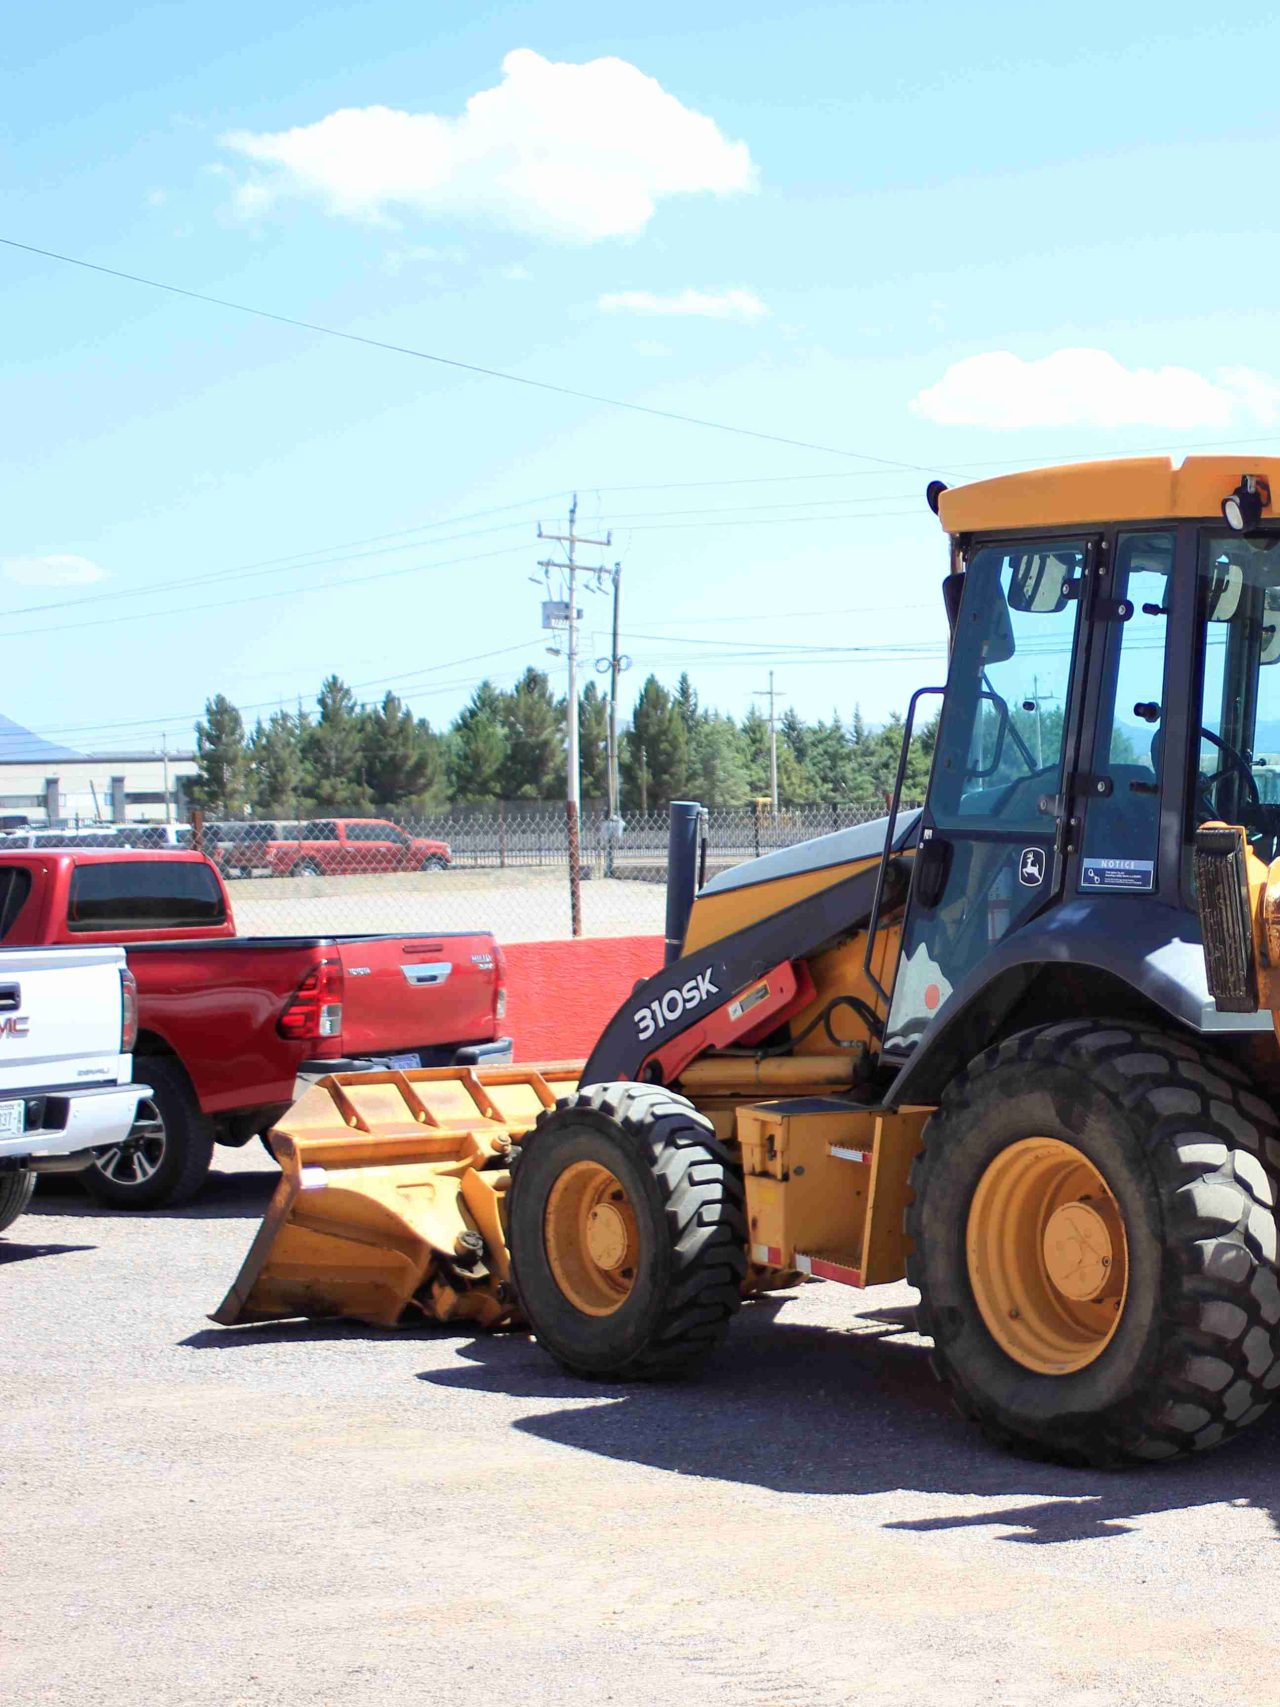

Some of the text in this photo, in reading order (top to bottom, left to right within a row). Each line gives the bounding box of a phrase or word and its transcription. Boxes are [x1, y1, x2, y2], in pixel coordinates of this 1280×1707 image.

[1101, 860, 1135, 869] NOTICE
[633, 967, 720, 1040] 310SK
[0, 1016, 29, 1037] MC
